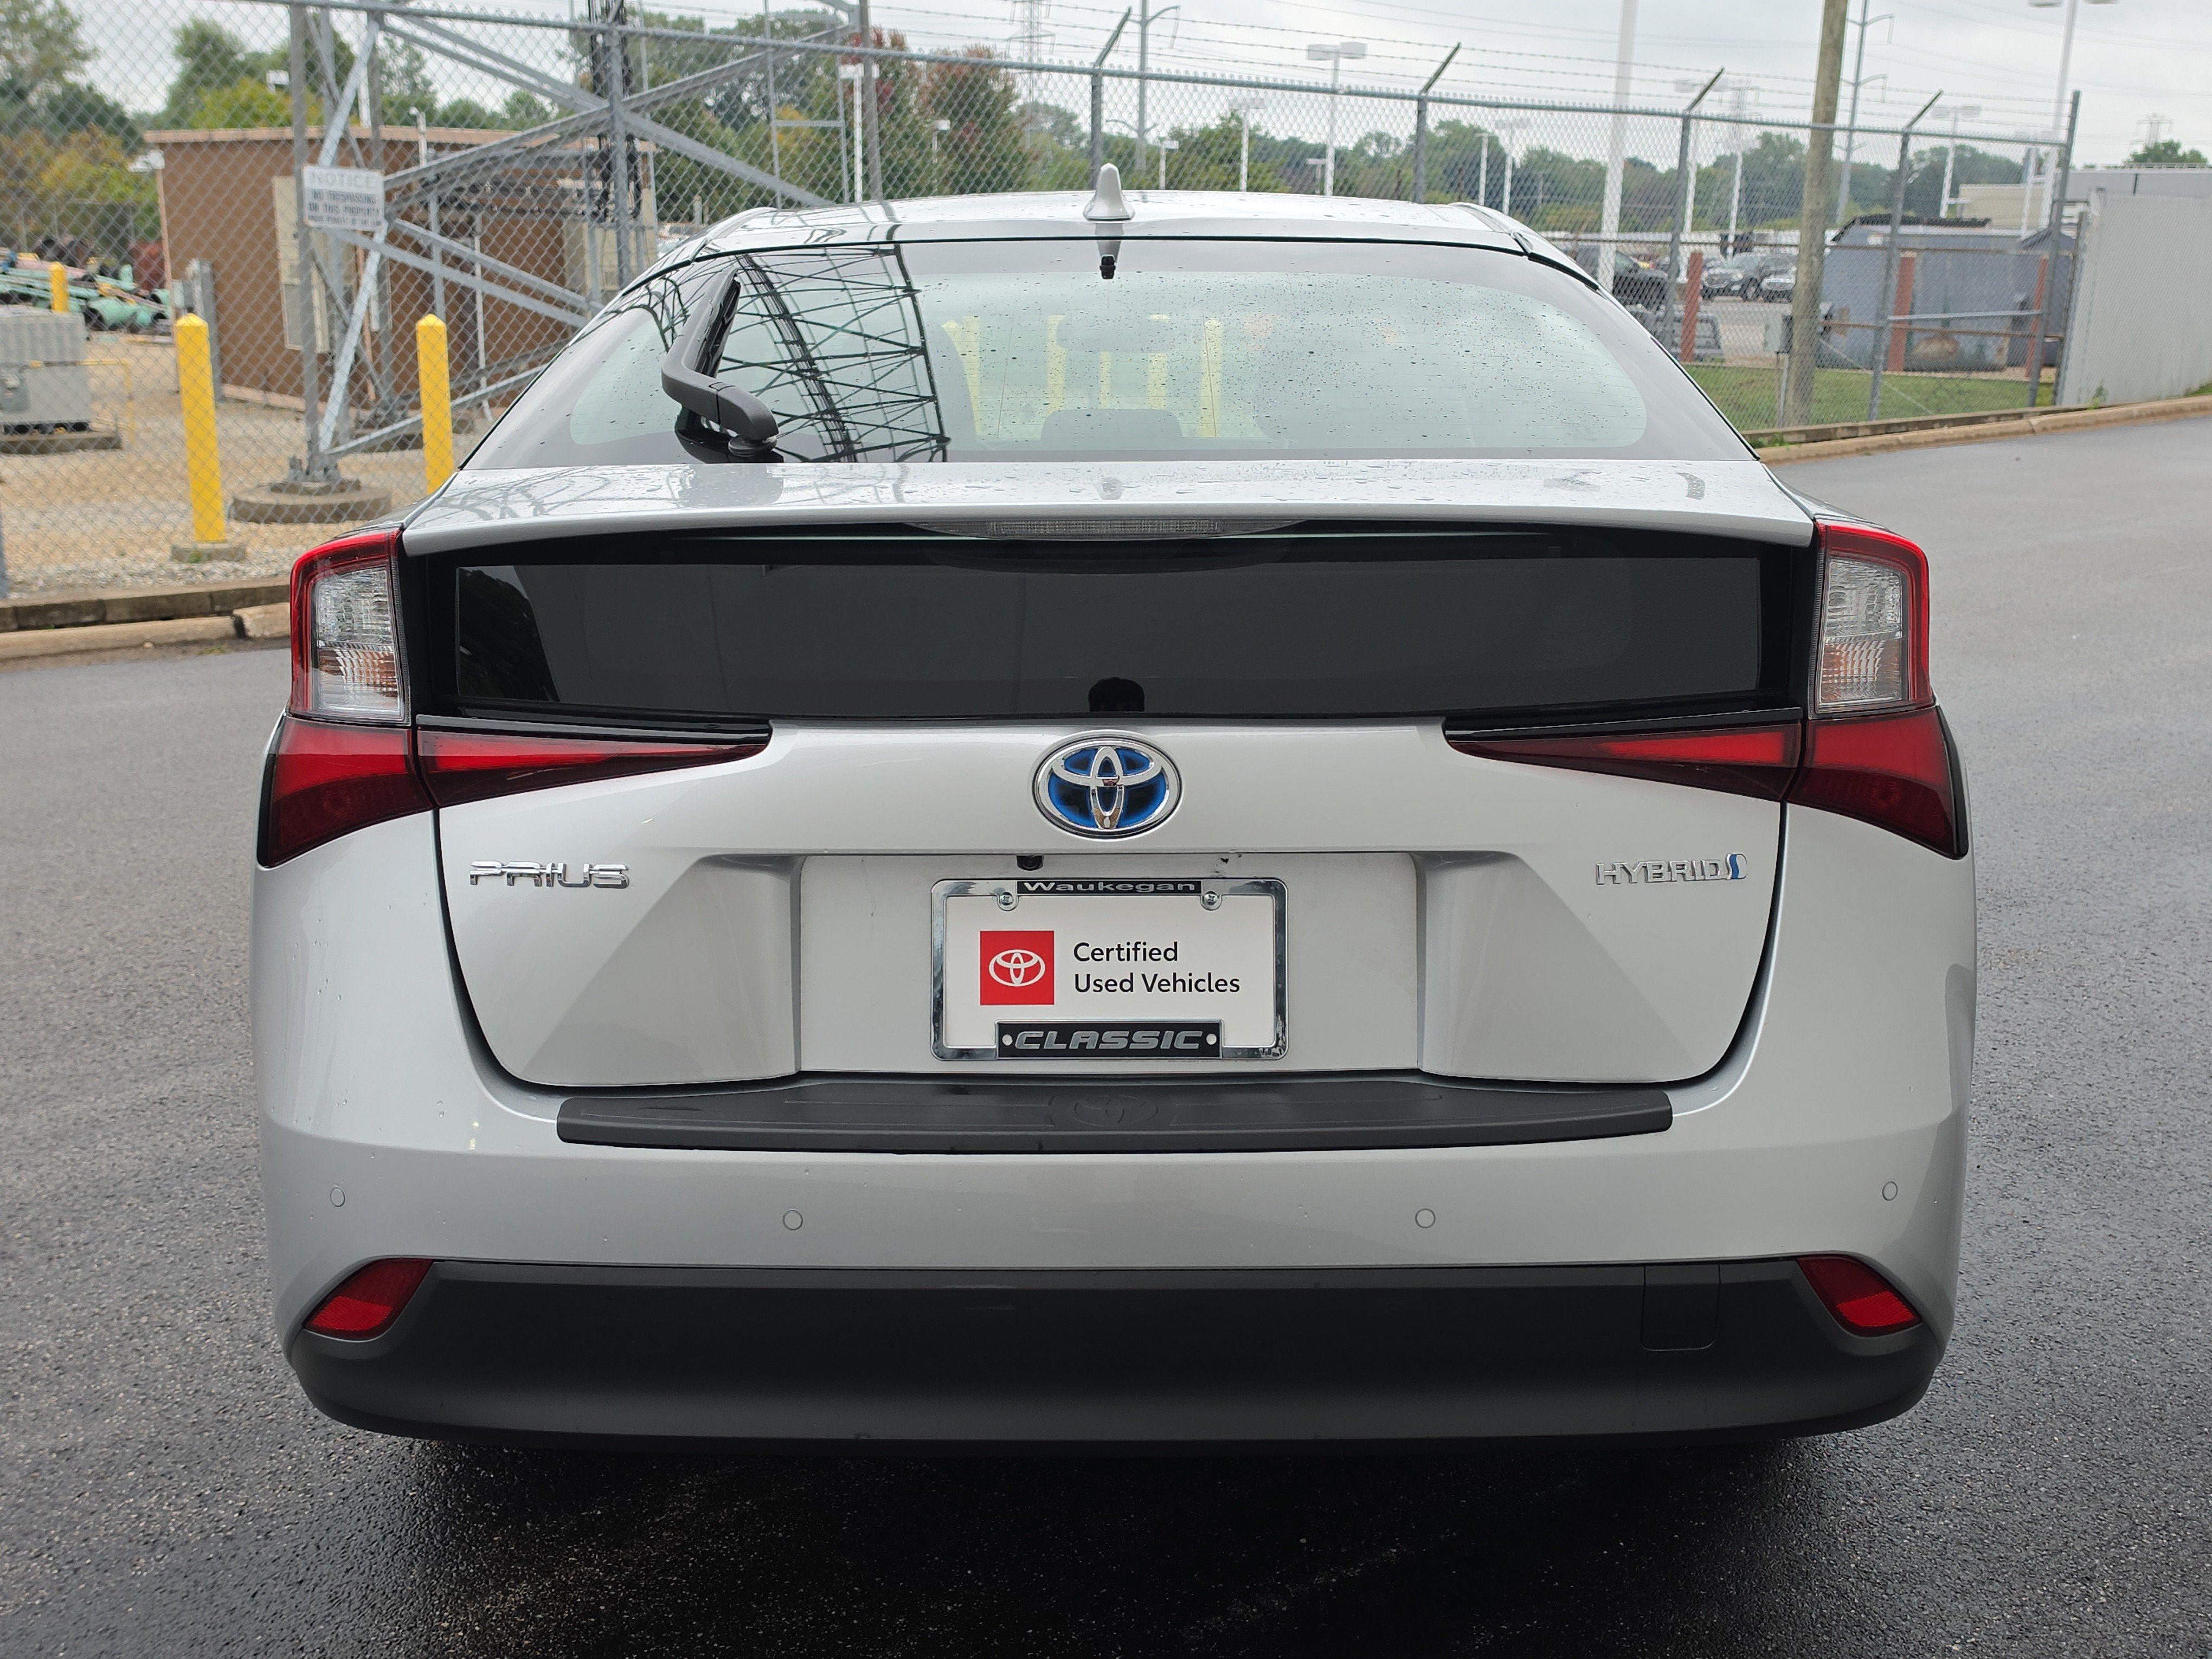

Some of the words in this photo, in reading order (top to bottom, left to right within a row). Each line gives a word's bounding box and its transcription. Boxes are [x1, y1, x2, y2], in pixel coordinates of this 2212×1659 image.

[310, 171, 377, 190] NOTICE
[469, 861, 630, 889] PRIUS
[1596, 859, 1725, 885] HYBRID
[1023, 880, 1196, 893] Waukegan
[1073, 941, 1178, 963] Certified
[1074, 972, 1134, 993] Used
[1141, 972, 1240, 993] Vehicles
[1014, 1031, 1203, 1050] CLASSIC
